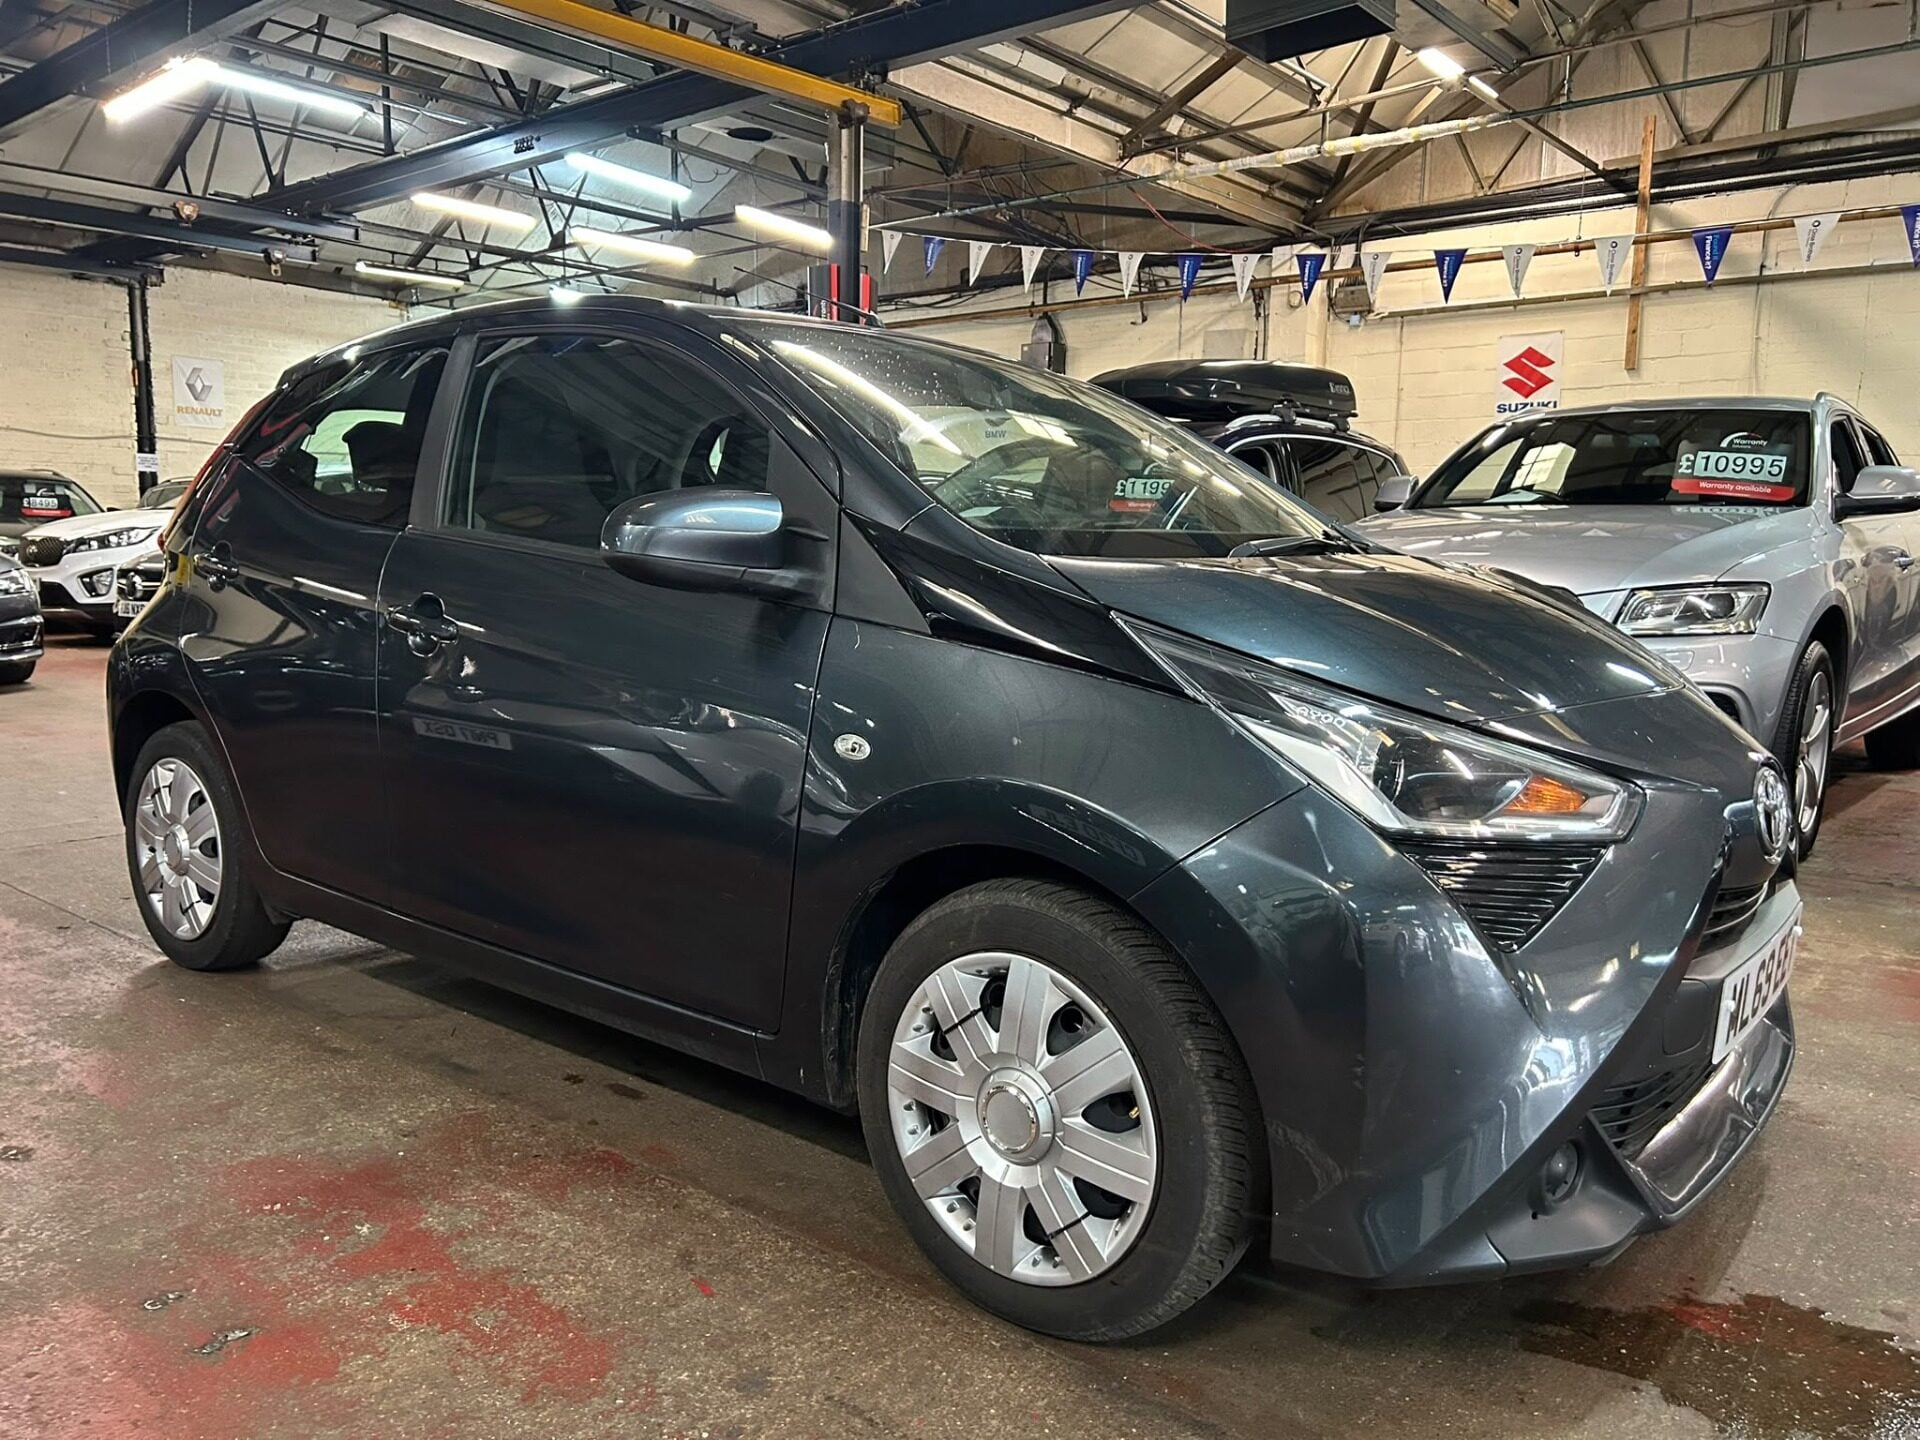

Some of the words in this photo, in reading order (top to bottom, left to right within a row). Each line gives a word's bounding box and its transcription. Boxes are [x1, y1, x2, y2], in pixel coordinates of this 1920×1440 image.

[1704, 235, 1713, 260] Finance
[1704, 260, 1712, 270] it?
[176, 405, 224, 417] RENAULT
[984, 429, 1007, 439] BMW
[1732, 438, 1768, 447] Warranty
[1678, 453, 1784, 477] £10995
[1699, 480, 1735, 492] Warranty
[1735, 485, 1772, 495] available
